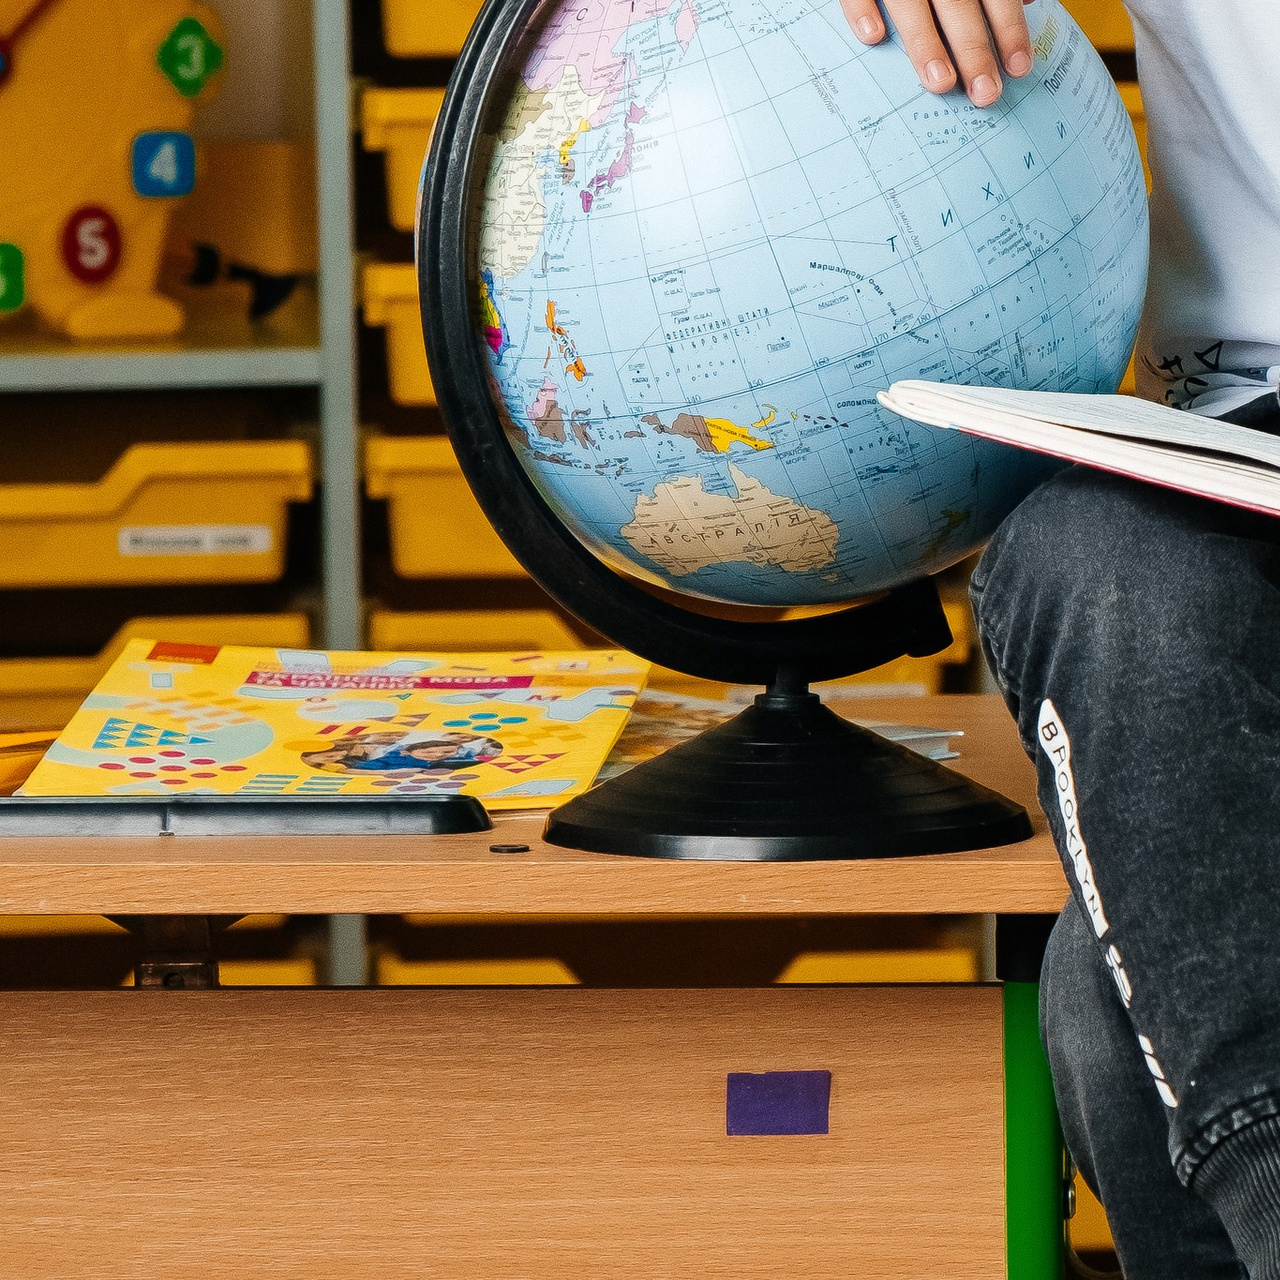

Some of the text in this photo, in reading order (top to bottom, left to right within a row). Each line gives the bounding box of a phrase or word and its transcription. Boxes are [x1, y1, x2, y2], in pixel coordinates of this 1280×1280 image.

[177, 34, 205, 81] 3
[808, 74, 837, 115] Понеділок
[819, 67, 839, 95] Неділя
[150, 142, 177, 189] 4
[77, 219, 111, 269] 5
[809, 261, 865, 281] Маршаллові
[666, 307, 770, 341] ФЕДЕРАТИВНІ ШТАТИ
[917, 313, 931, 325] 180
[875, 332, 889, 344] 170
[814, 357, 830, 368] 160
[749, 378, 764, 389] 150
[629, 405, 643, 414] 130
[836, 398, 878, 409] СОЛОМОНО
[650, 512, 801, 546] АВСТРАЛІЯ
[1040, 721, 1099, 918] BROOKLYN
